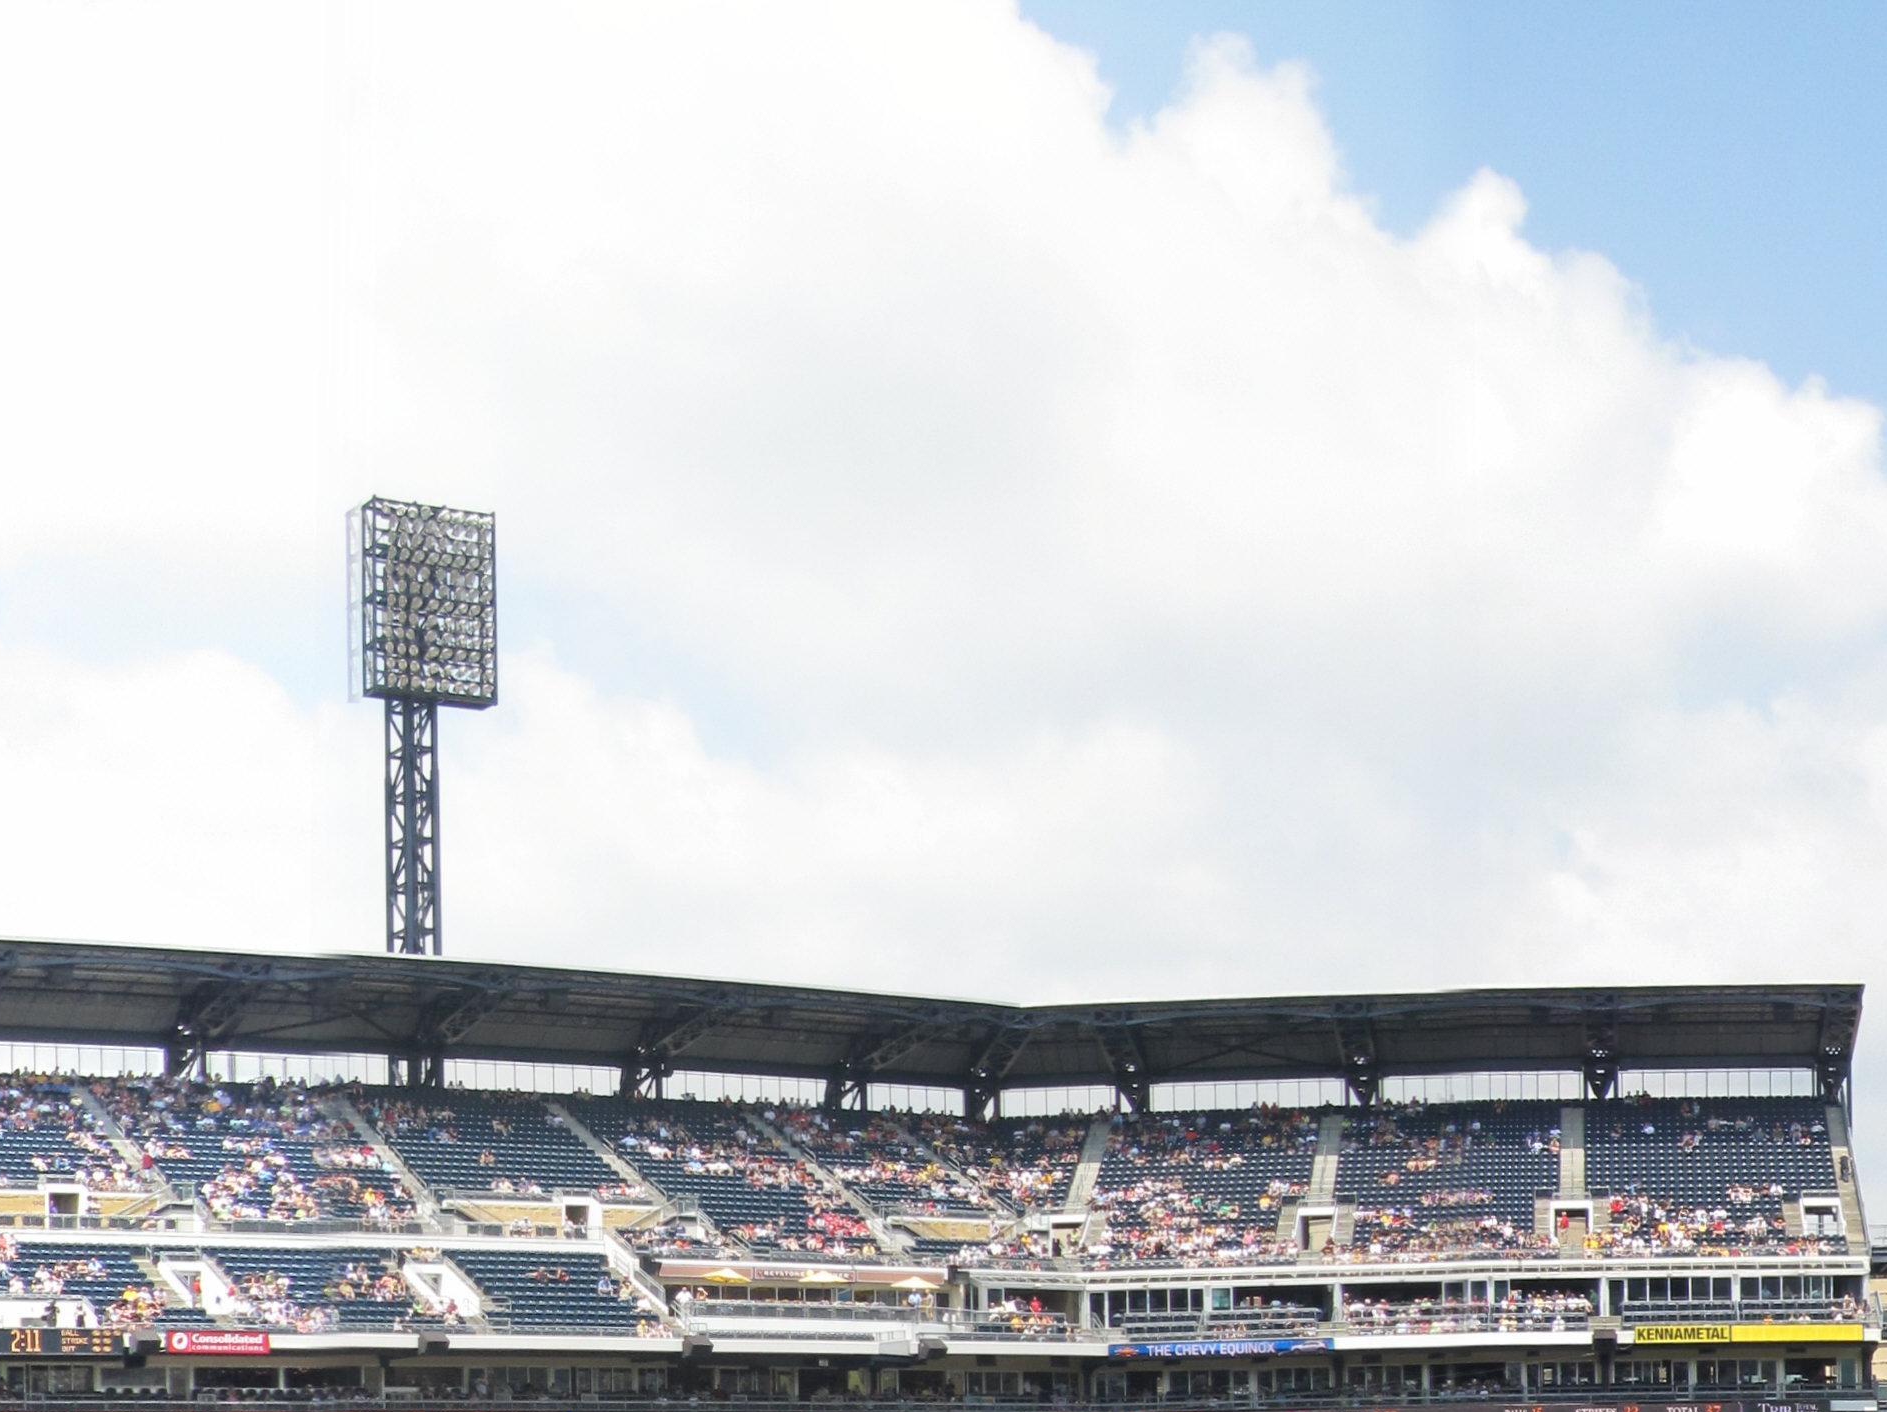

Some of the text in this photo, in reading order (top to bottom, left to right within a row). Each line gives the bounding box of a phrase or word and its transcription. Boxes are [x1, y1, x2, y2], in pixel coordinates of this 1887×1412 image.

[192, 1333, 263, 1343] Consolidated
[1637, 1327, 1728, 1341] KENNAMETAL
[11, 1330, 41, 1352] 2:11
[1146, 1343, 1274, 1356] THE CHEVY EQUINOX
